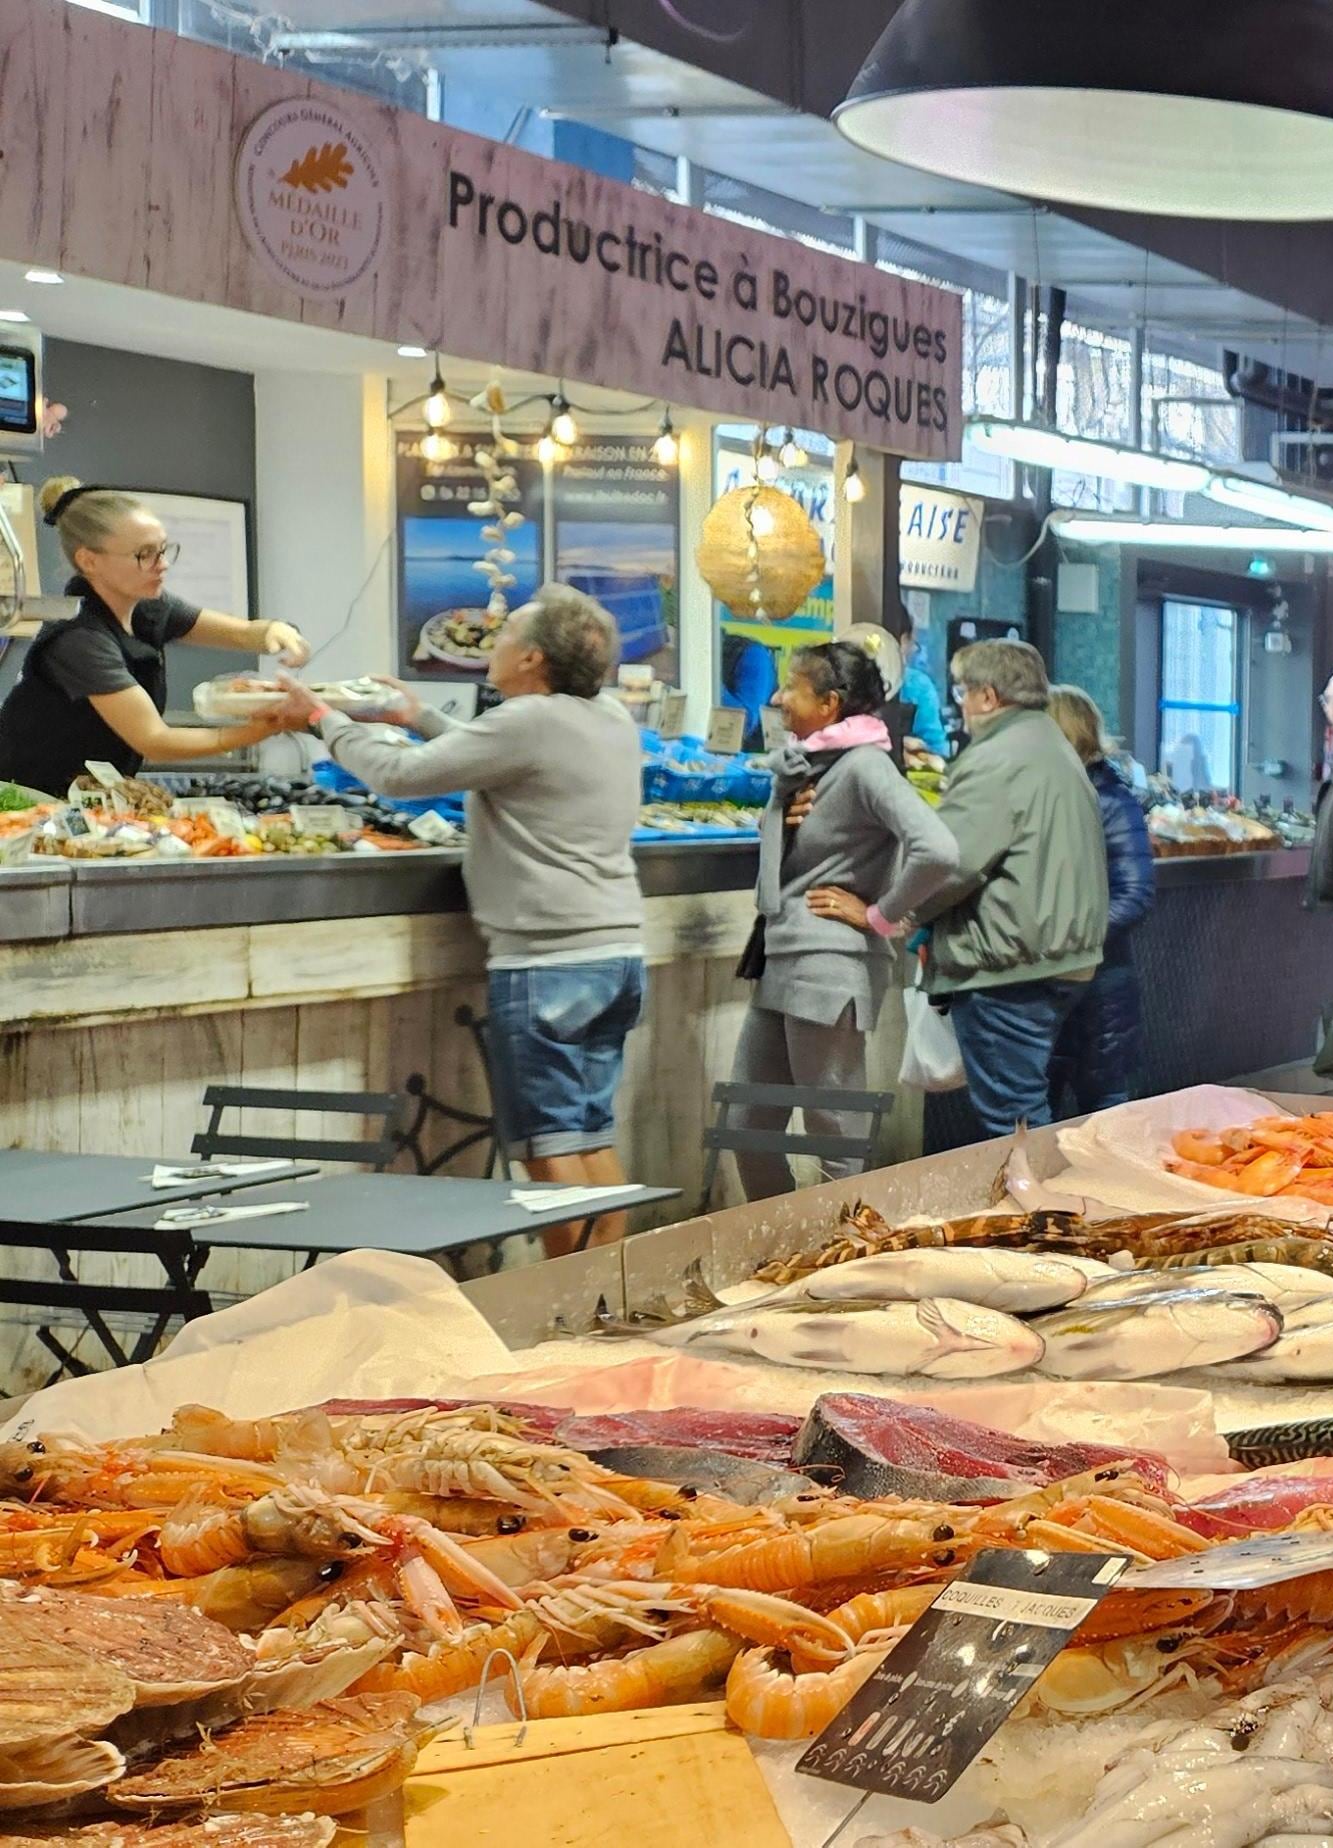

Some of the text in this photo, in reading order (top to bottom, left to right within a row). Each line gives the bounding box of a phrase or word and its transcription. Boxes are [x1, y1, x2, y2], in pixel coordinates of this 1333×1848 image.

[449, 170, 719, 300] Productrice
[733, 253, 758, 311] à
[773, 269, 947, 364] Bouzigues
[662, 318, 949, 433] ALICIA ROQUES
[942, 1589, 1001, 1609] COQUILLES
[1020, 1601, 1077, 1619] JACQUES
